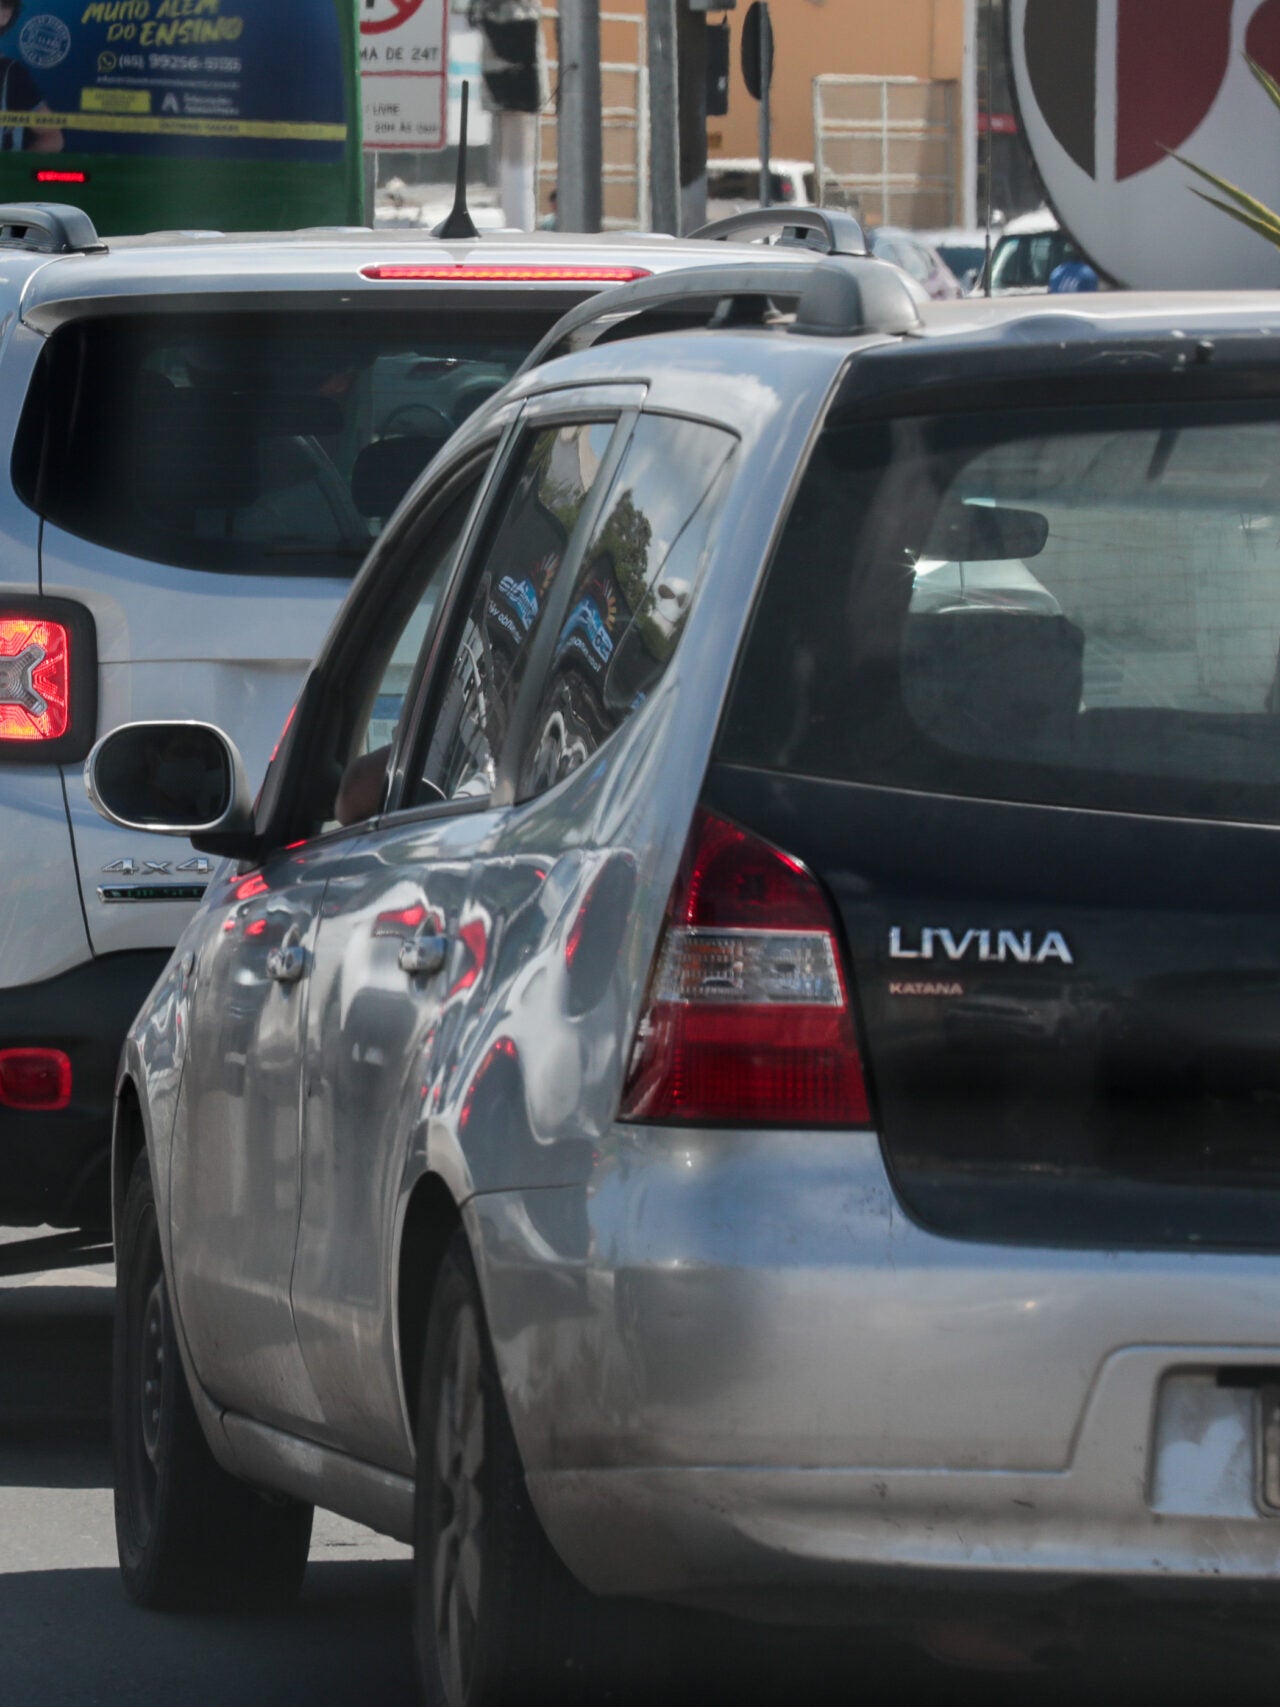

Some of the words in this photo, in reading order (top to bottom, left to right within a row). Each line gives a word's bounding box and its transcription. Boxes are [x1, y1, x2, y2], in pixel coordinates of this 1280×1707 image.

[107, 23, 137, 42] DO
[139, 17, 244, 46] ENSINO
[385, 46, 403, 60] DE
[101, 857, 215, 875] 4x4
[888, 926, 1074, 964] LIVINA
[889, 982, 963, 996] KATANA
